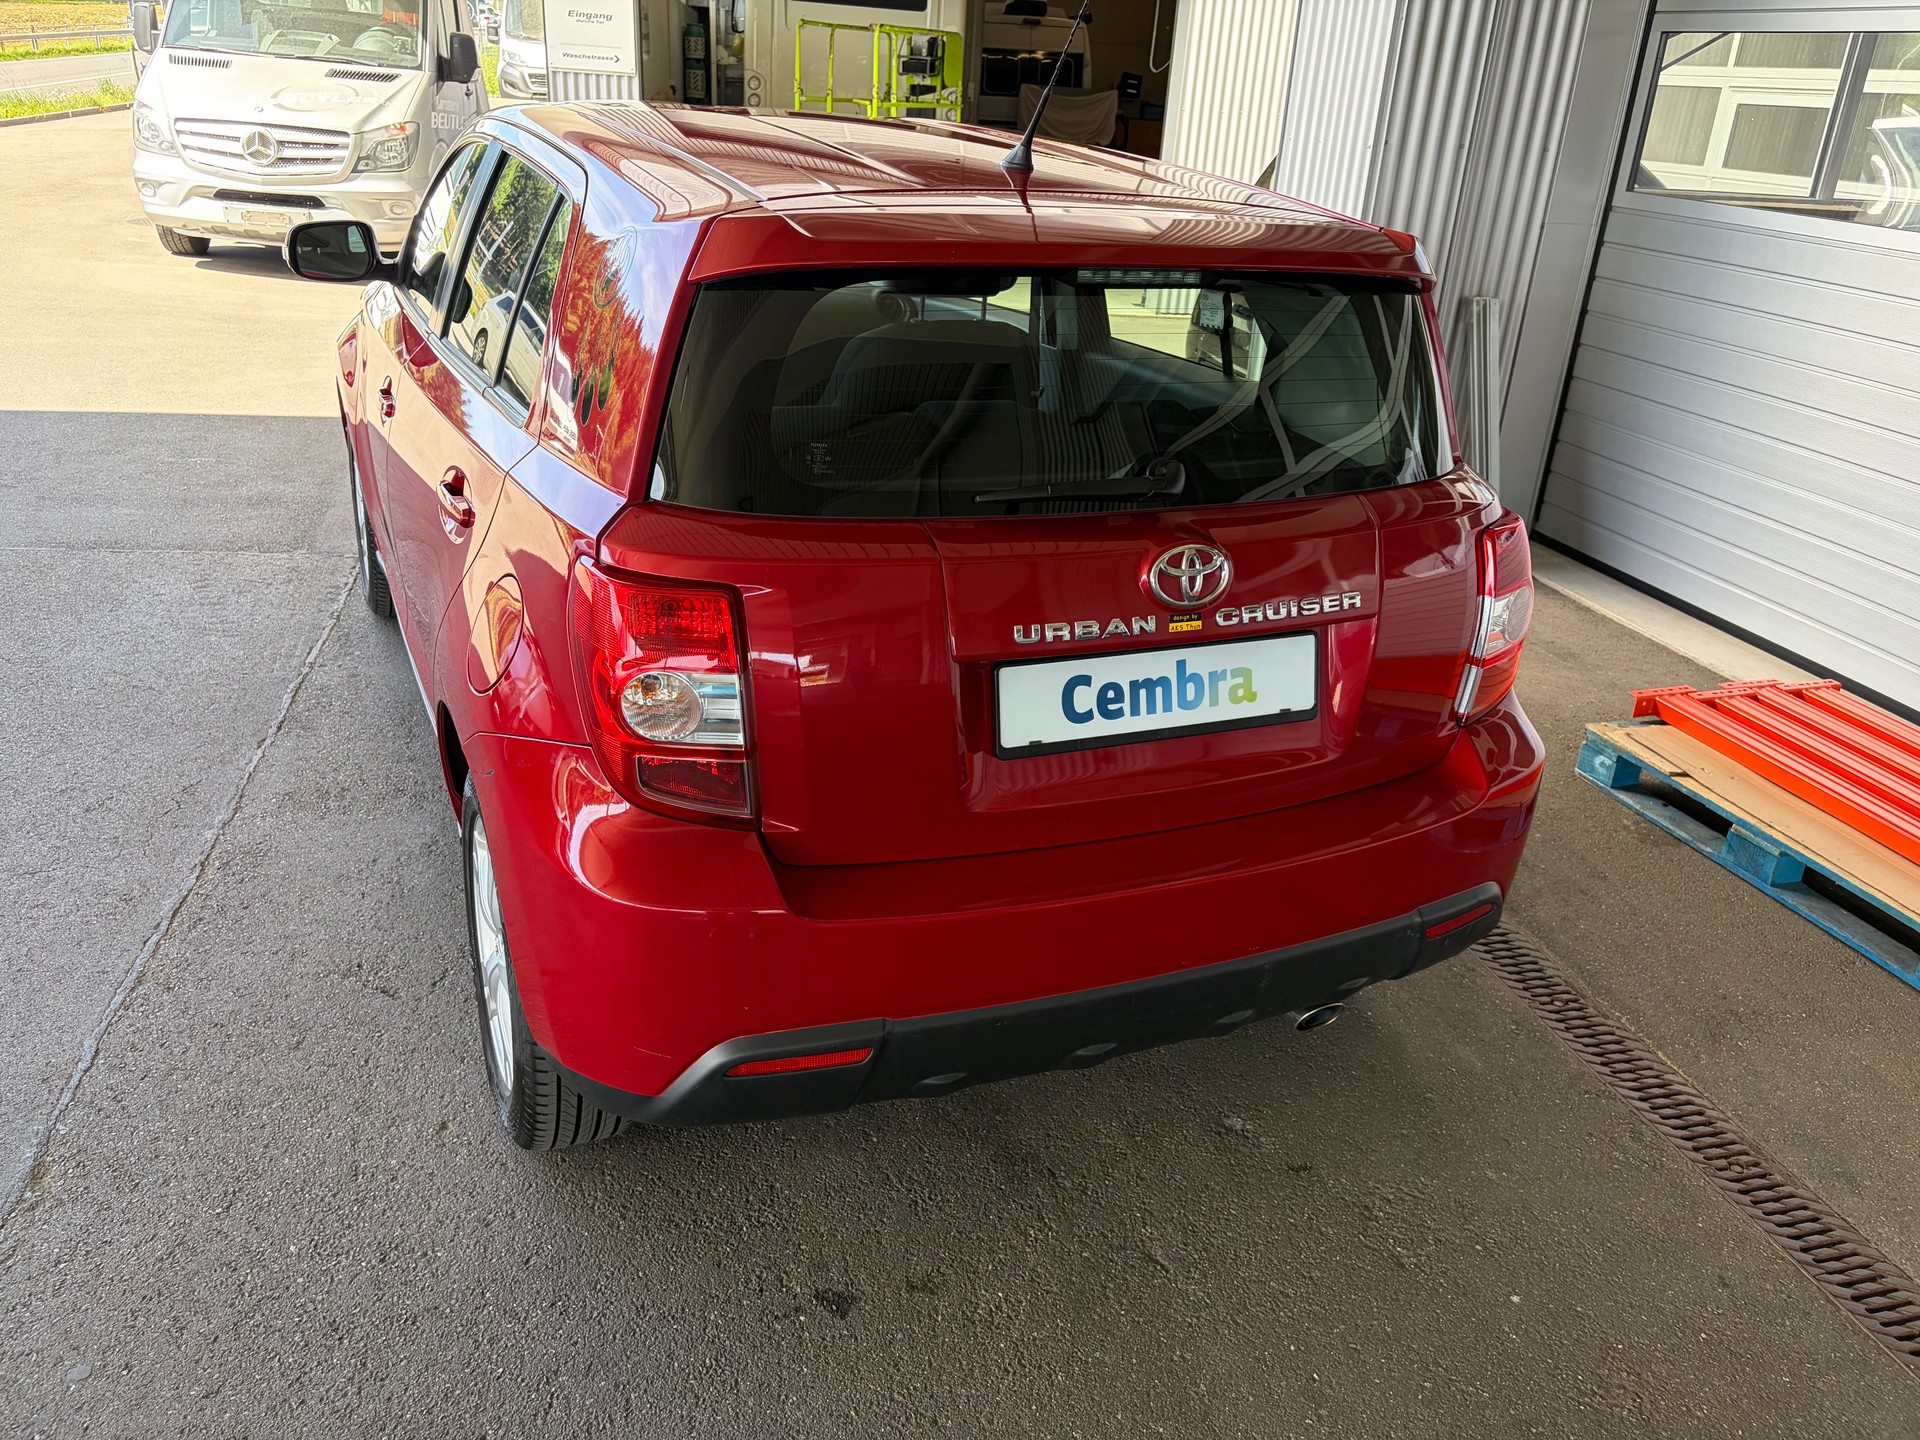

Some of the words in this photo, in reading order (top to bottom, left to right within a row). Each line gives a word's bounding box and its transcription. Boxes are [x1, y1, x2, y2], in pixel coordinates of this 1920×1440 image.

[568, 10, 612, 21] Eingang
[562, 52, 614, 60] Waschstrasse
[1013, 614, 1156, 644] URBAN
[1215, 591, 1362, 627] CRUISER
[1061, 658, 1258, 724] Cembra
